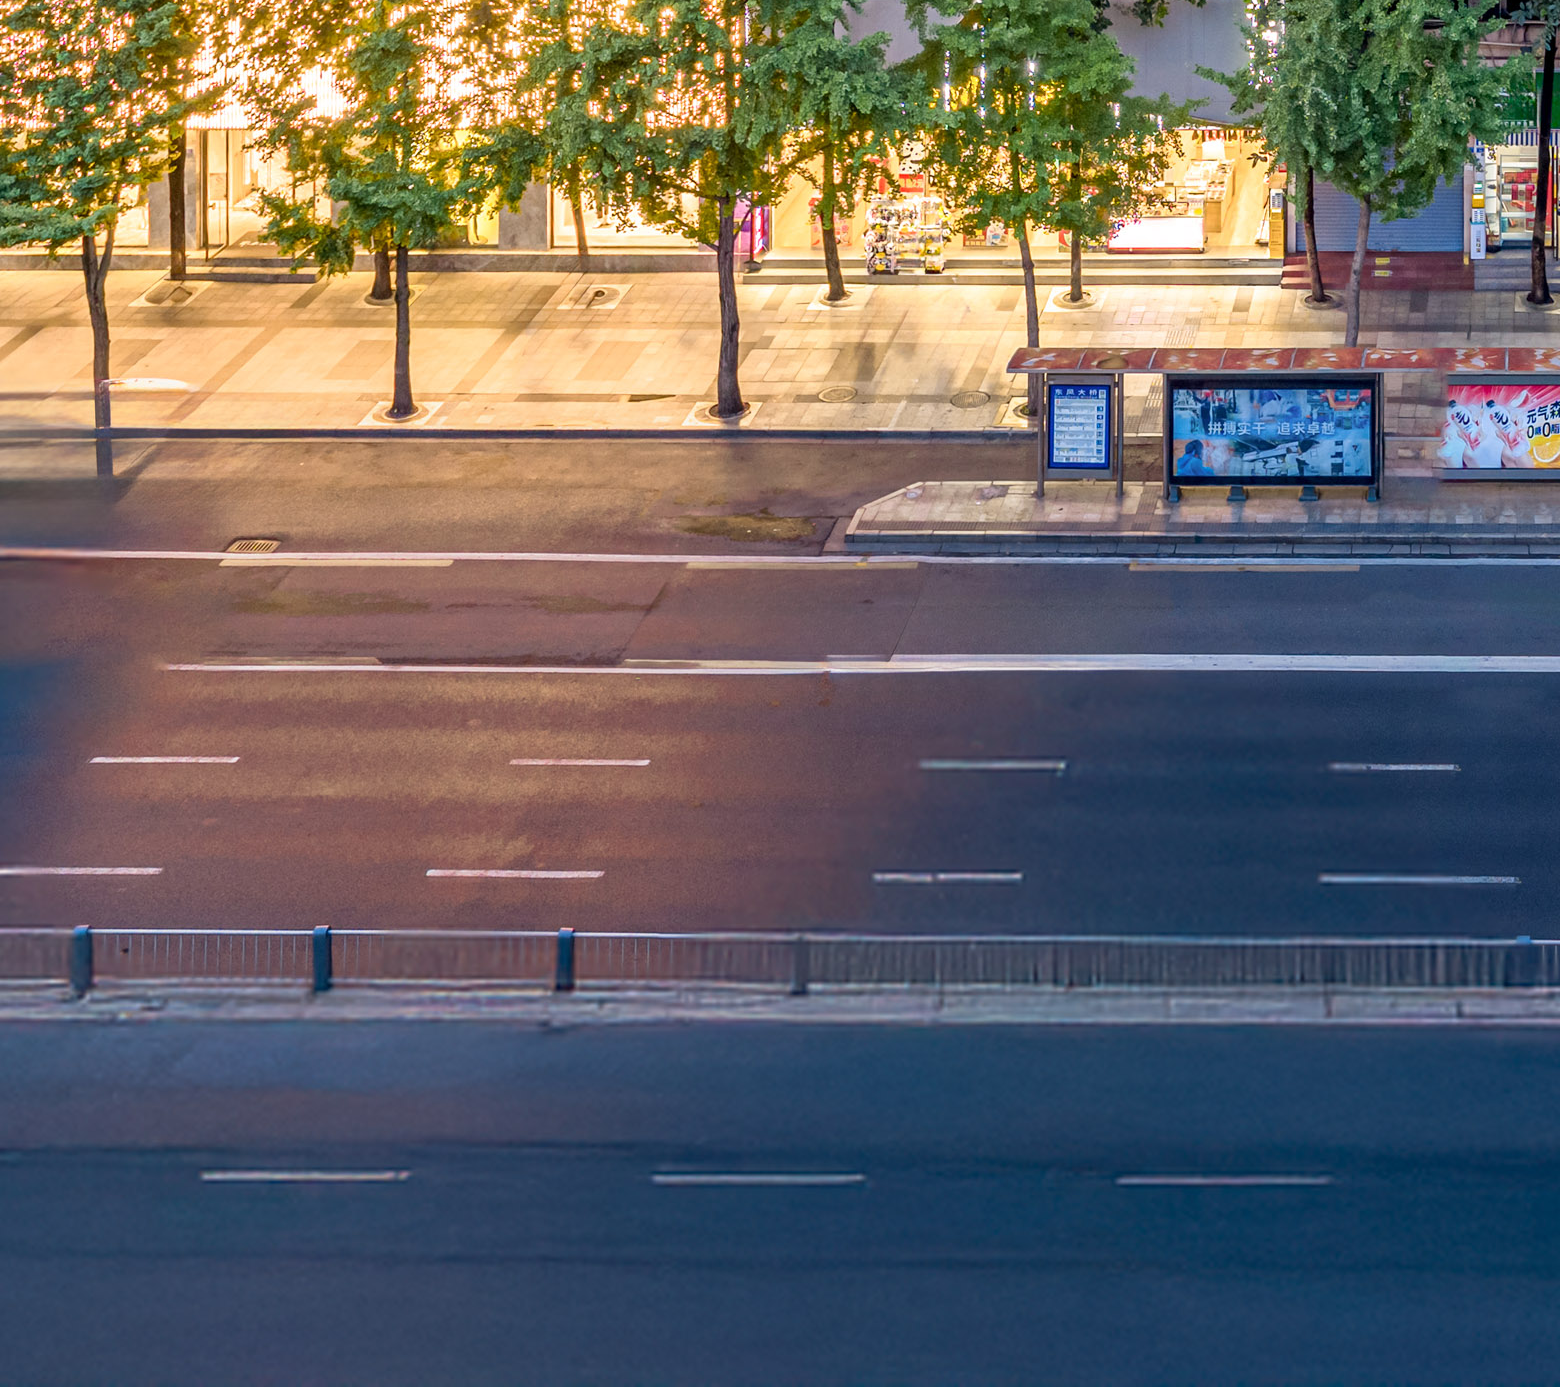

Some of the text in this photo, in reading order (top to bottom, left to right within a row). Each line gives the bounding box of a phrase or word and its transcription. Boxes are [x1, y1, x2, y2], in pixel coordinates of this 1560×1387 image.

[1208, 422, 1336, 435] 拼搏实干 追求卓越
